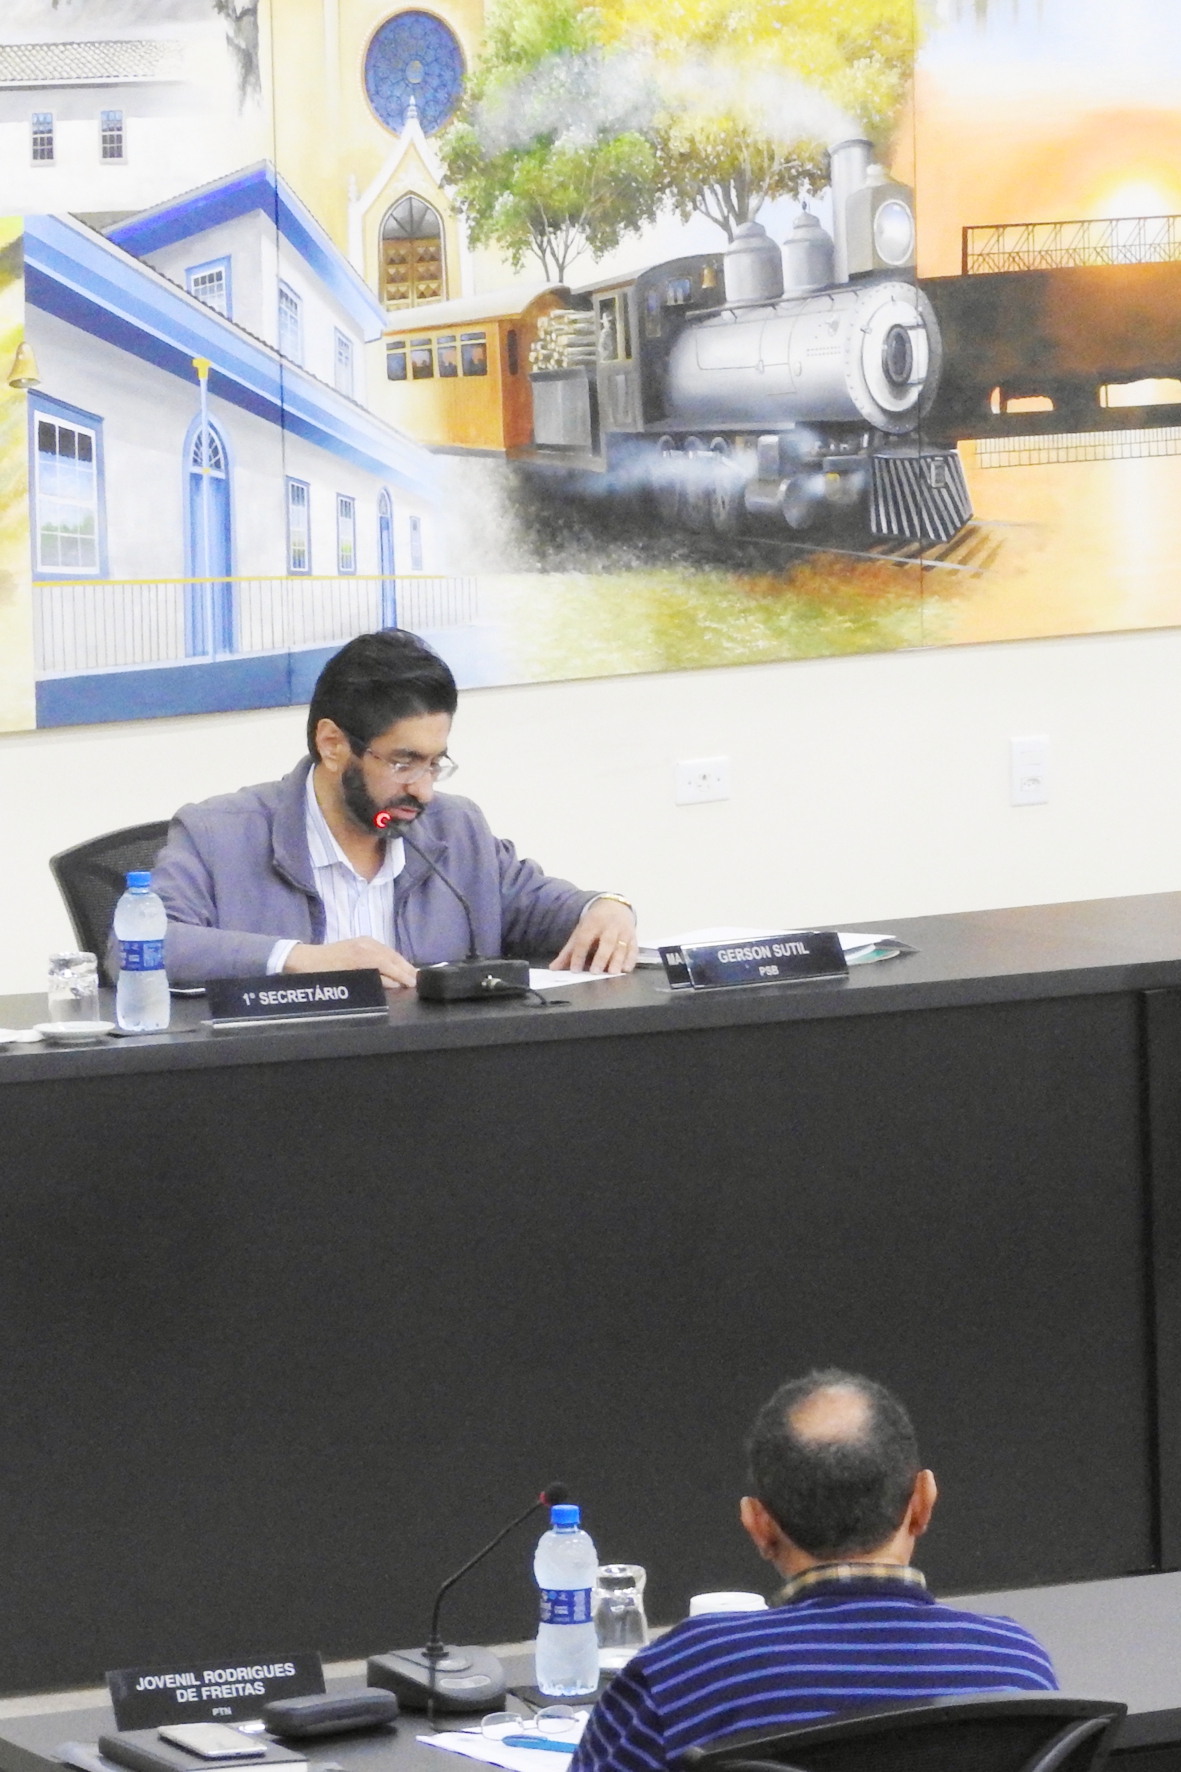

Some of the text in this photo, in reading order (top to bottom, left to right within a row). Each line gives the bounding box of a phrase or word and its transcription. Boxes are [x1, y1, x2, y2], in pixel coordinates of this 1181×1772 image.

[717, 942, 810, 964] GERSON SUTIL
[758, 965, 780, 977] PSB
[259, 984, 349, 1006] SECRETÁRIO
[136, 1662, 296, 1691] JOVENIL RODRIGUES
[176, 1682, 266, 1703] DE FREITAS
[212, 1706, 232, 1716] PTN
